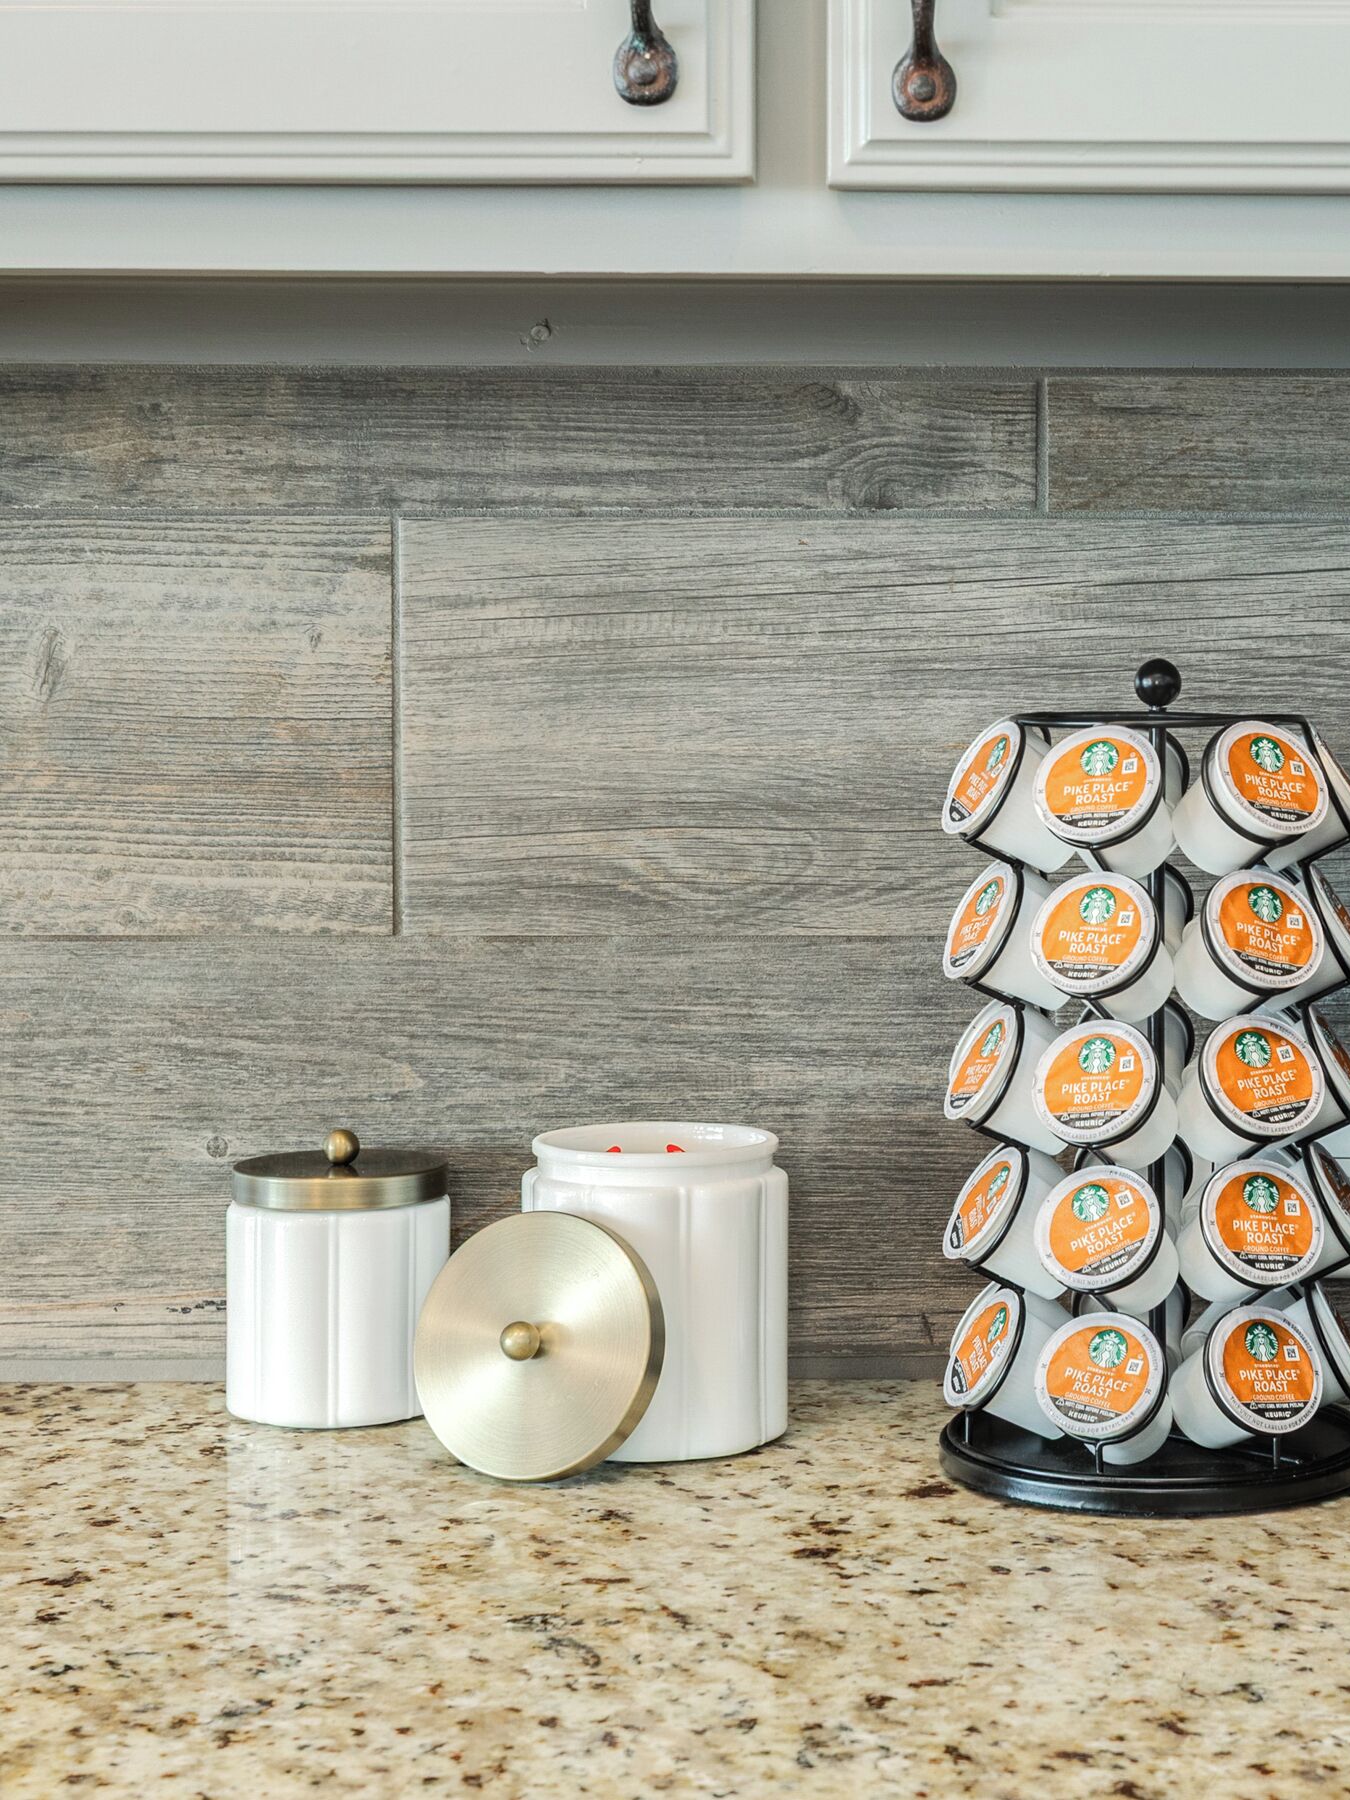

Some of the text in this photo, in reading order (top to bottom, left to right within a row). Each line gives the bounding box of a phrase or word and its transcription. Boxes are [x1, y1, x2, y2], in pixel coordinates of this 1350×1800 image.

[1064, 781, 1129, 796] PIKE PLACE
[1245, 774, 1267, 787] PIKE
[1270, 779, 1303, 793] PLACE
[1075, 794, 1114, 804] ROAST
[1258, 786, 1292, 801] ROAST
[1059, 931, 1122, 944] PIKE PLACE
[1236, 922, 1261, 937] PIKE
[1264, 930, 1296, 946] PLACE
[1069, 943, 1107, 954] ROAST
[1249, 935, 1284, 953] ROAST
[1062, 1080, 1126, 1094] PIKE PLACE
[1237, 1070, 1296, 1091] PIKE PLACE
[1074, 1092, 1111, 1104] ROAST
[1253, 1084, 1288, 1099] ROAST
[1277, 1095, 1296, 1103] COFFEE
[1071, 1231, 1096, 1251] PIKE
[1098, 1215, 1134, 1238] PLACE
[1233, 1220, 1295, 1235] PIKE PLACE
[1087, 1231, 1124, 1255] ROAST
[1247, 1232, 1284, 1244] ROAST
[1064, 1367, 1129, 1392] PIKE PLACE
[1239, 1369, 1298, 1380] PIKE PLACE
[1073, 1381, 1112, 1399] ROAST
[1254, 1381, 1288, 1392] ROAST
